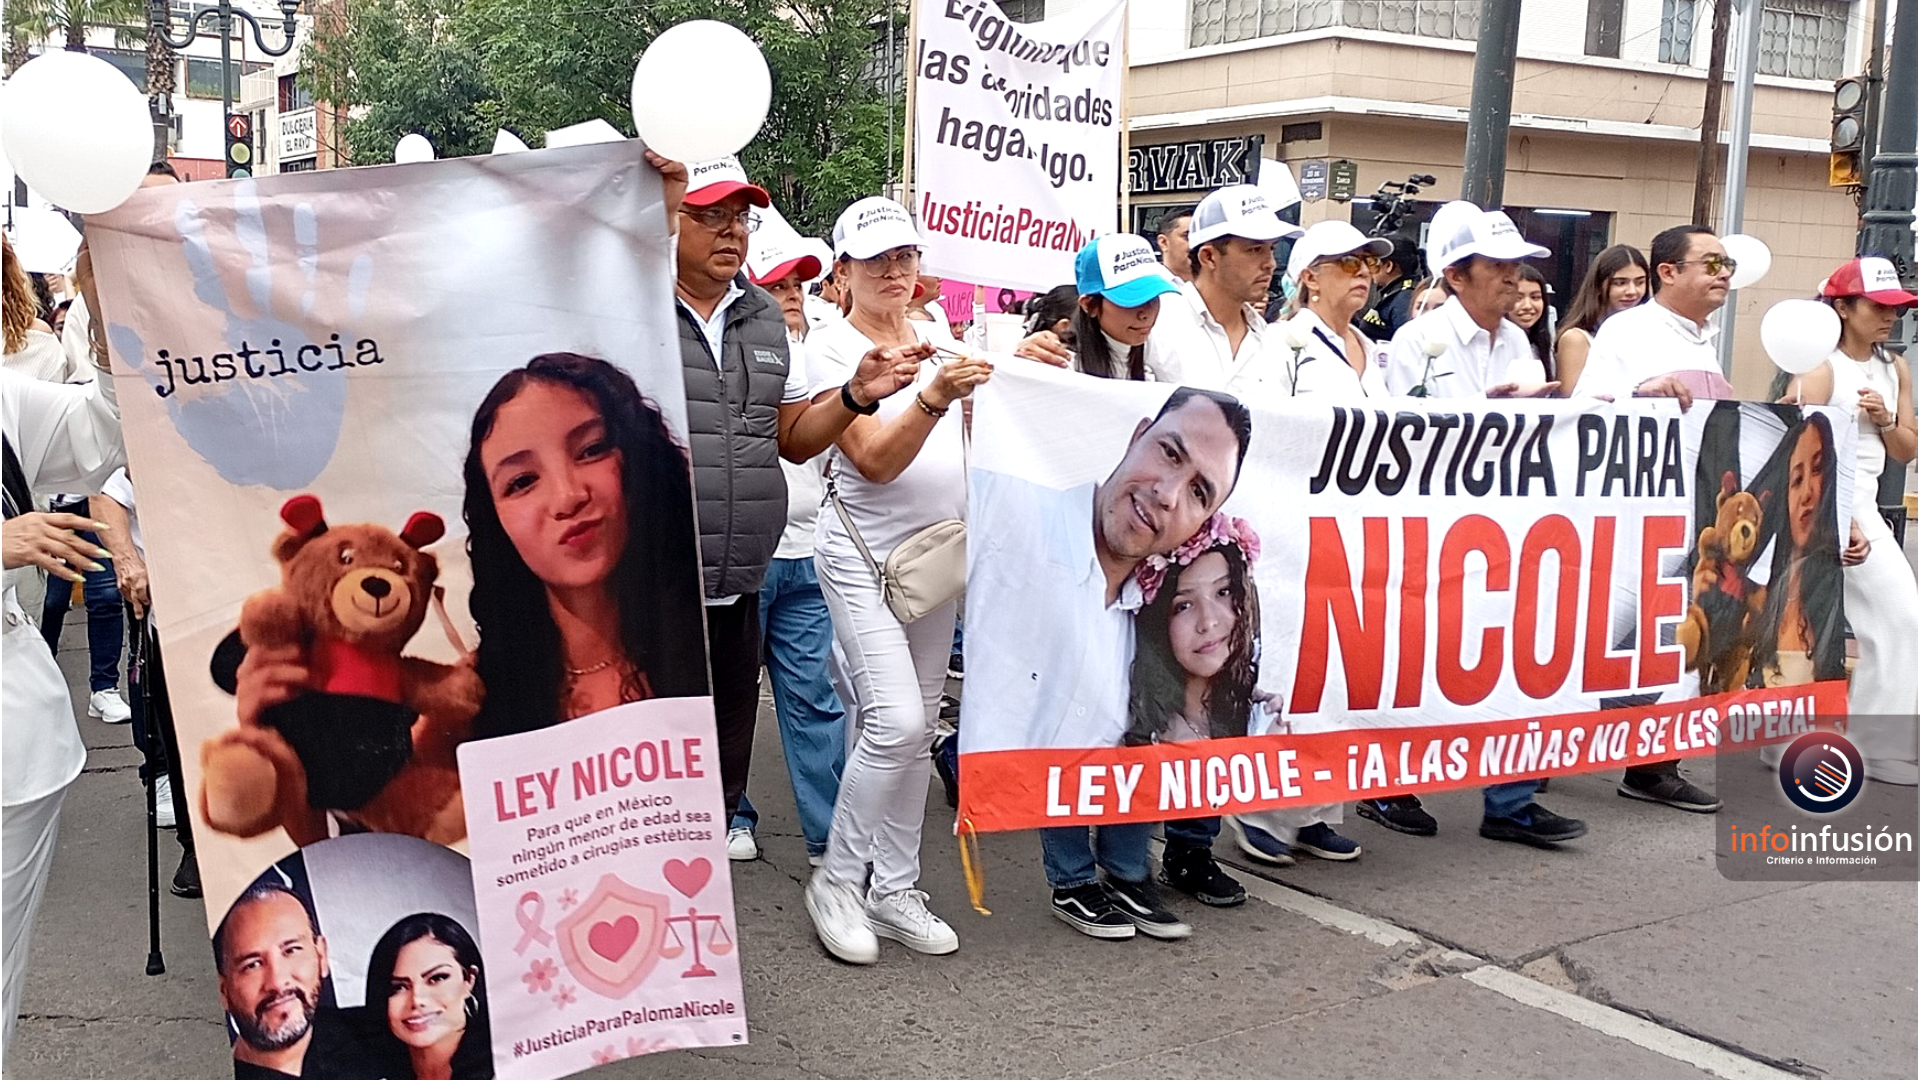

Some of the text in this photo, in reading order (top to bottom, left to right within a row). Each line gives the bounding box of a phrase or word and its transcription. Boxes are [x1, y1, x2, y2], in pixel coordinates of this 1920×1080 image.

[917, 39, 1112, 126] las aoridades
[936, 106, 1034, 162] haga
[155, 333, 384, 398] justicia
[1309, 406, 1686, 497] JUSTICIA PARA
[1288, 513, 1688, 714] NICOLE
[493, 738, 705, 822] LEY NICOLE
[1046, 763, 1144, 817] LEY
[1158, 749, 1302, 811] NICOLE
[1399, 737, 1469, 787] LAS
[1478, 721, 1586, 778] NIÑAS
[1587, 722, 1629, 764] NO
[1636, 715, 1678, 758] SE
[1673, 706, 1722, 751] LES
[1727, 695, 1816, 744] OPERA!
[512, 808, 713, 866] ningún menor de edad sea
[526, 794, 673, 842] Para que en México
[496, 857, 567, 887] sometido
[570, 855, 580, 866] a
[643, 827, 713, 846] estéticas
[512, 999, 735, 1060] #JusticiaParaPalomaNicole
